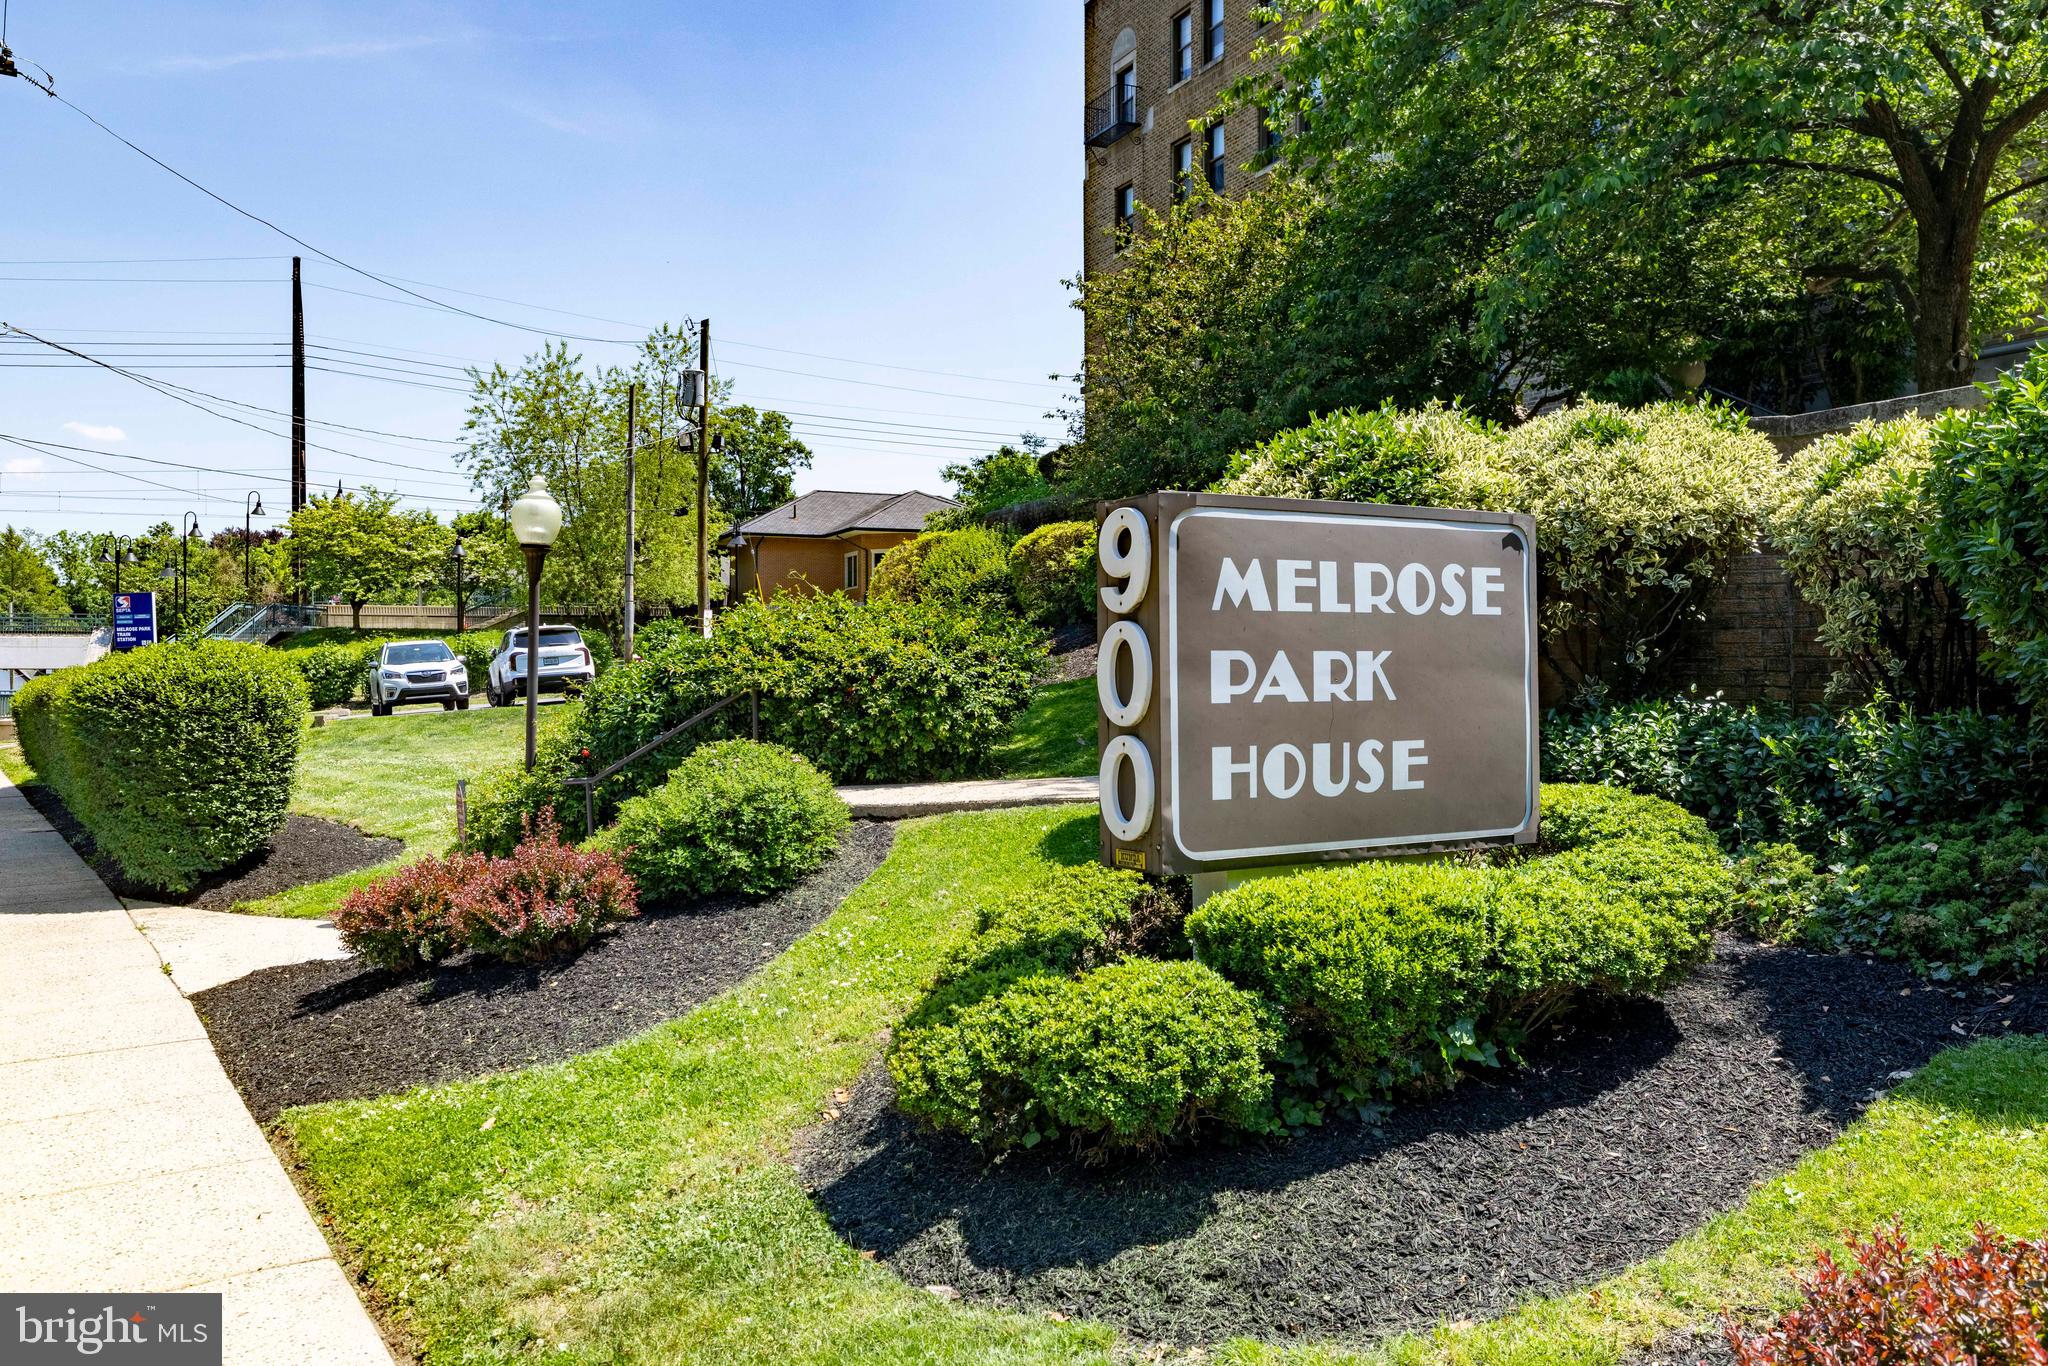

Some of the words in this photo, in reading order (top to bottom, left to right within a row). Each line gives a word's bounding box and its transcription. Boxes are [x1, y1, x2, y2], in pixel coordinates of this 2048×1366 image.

[1211, 557, 1505, 616] MELROSE
[1097, 507, 1154, 842] 900
[1210, 650, 1397, 704] PARK
[1211, 739, 1429, 801] HOUSE
